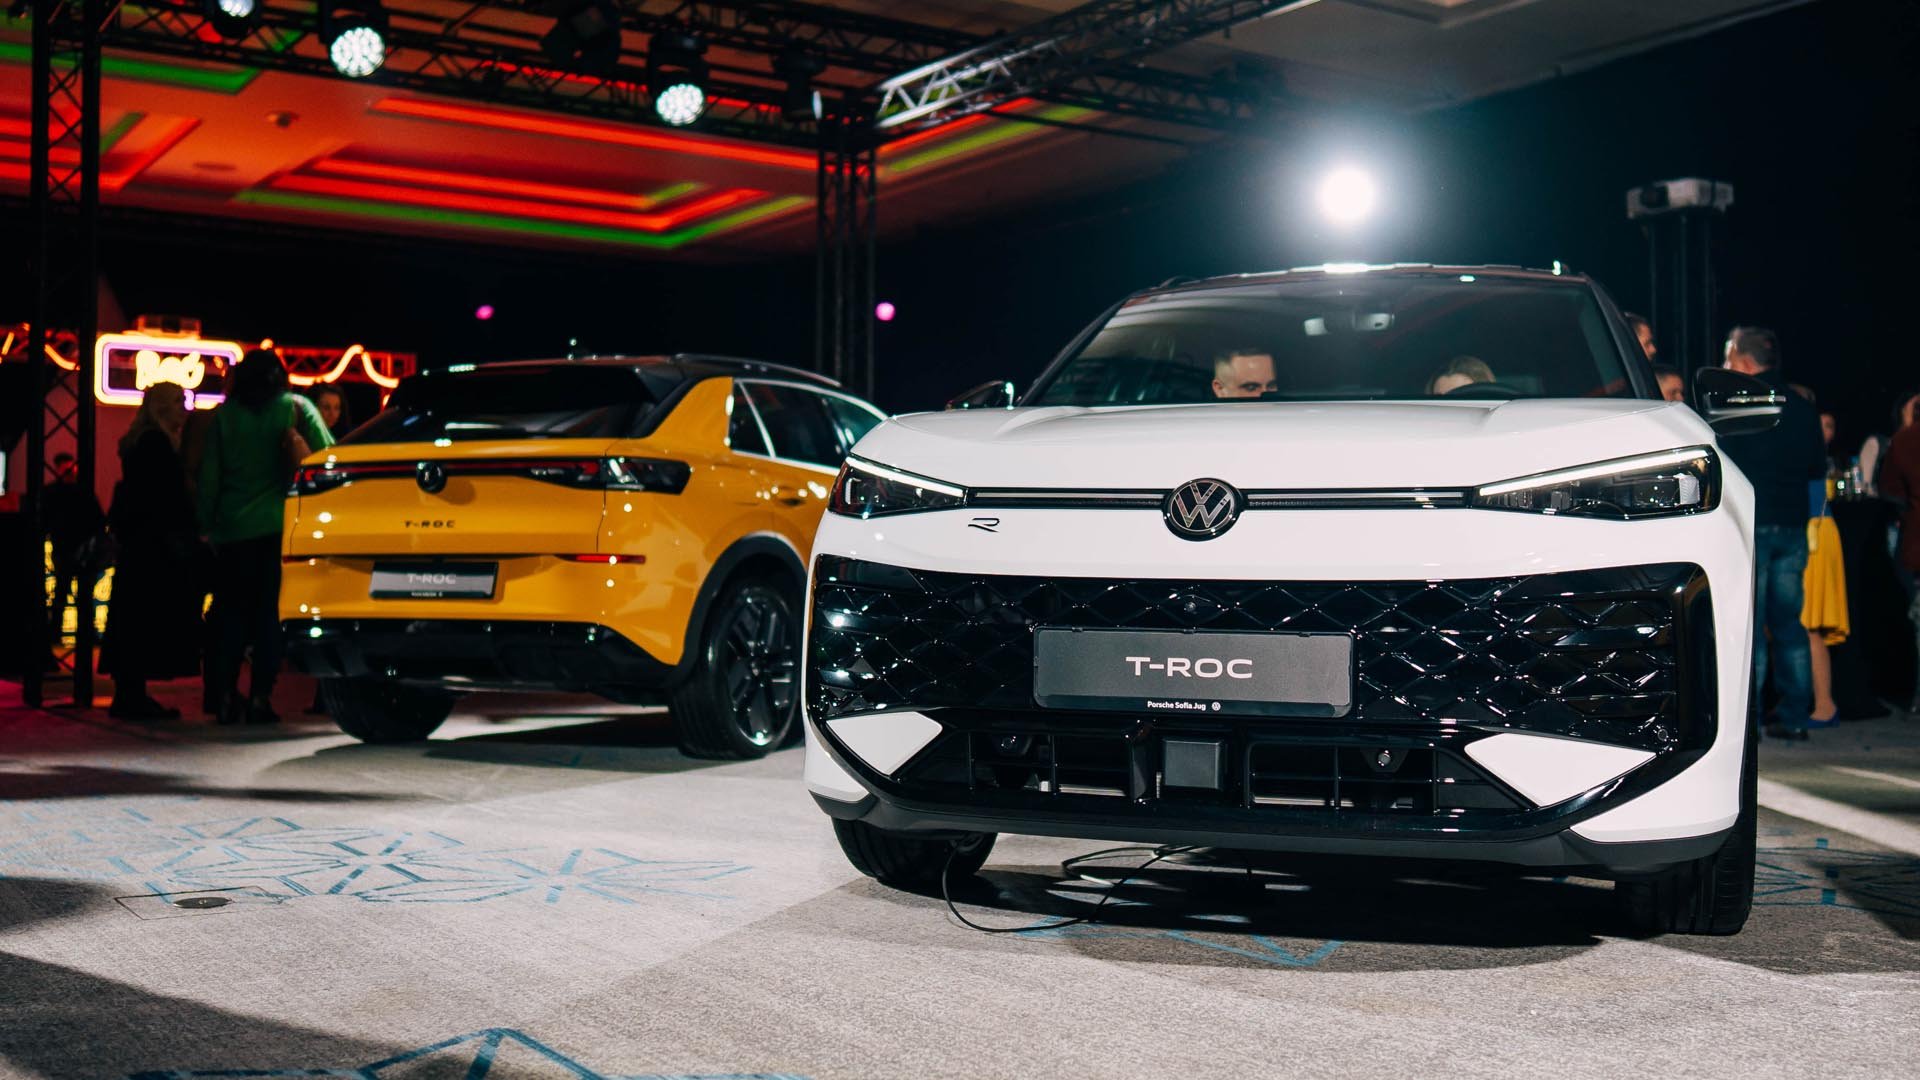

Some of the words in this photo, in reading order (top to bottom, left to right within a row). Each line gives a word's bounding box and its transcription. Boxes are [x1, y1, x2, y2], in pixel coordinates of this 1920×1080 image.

[404, 520, 456, 528] T-ROC
[407, 573, 457, 585] T-ROC
[1125, 656, 1253, 679] T-ROC
[1147, 700, 1174, 709] Porsche
[1175, 701, 1193, 710] Sofia
[1193, 702, 1207, 712] Jug
